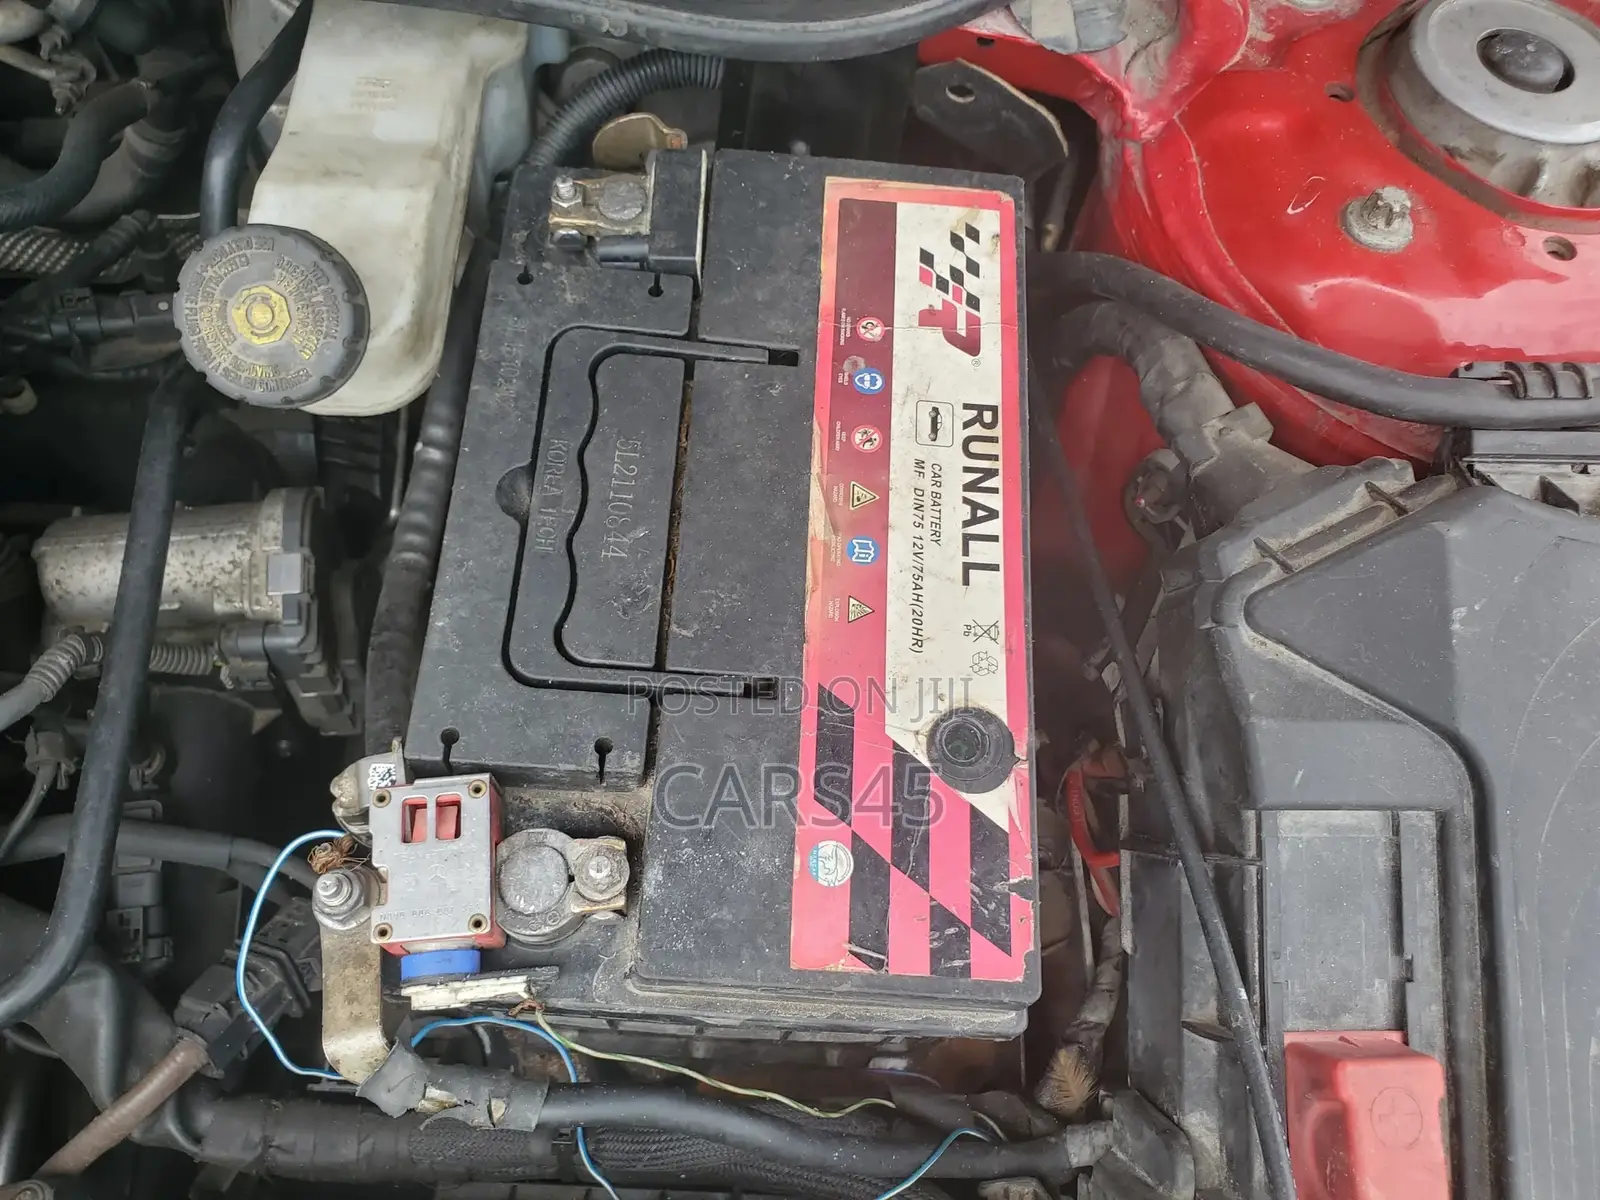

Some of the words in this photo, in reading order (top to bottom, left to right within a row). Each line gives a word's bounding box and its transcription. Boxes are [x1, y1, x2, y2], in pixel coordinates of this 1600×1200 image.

[914, 458, 925, 479] MF
[930, 463, 942, 489] CAR
[913, 487, 925, 529] DIN75
[961, 402, 1000, 586] RUNALL
[929, 491, 942, 547] BATTERY
[909, 535, 924, 654] 12V/75AH(20HR)
[963, 624, 972, 637] Pb
